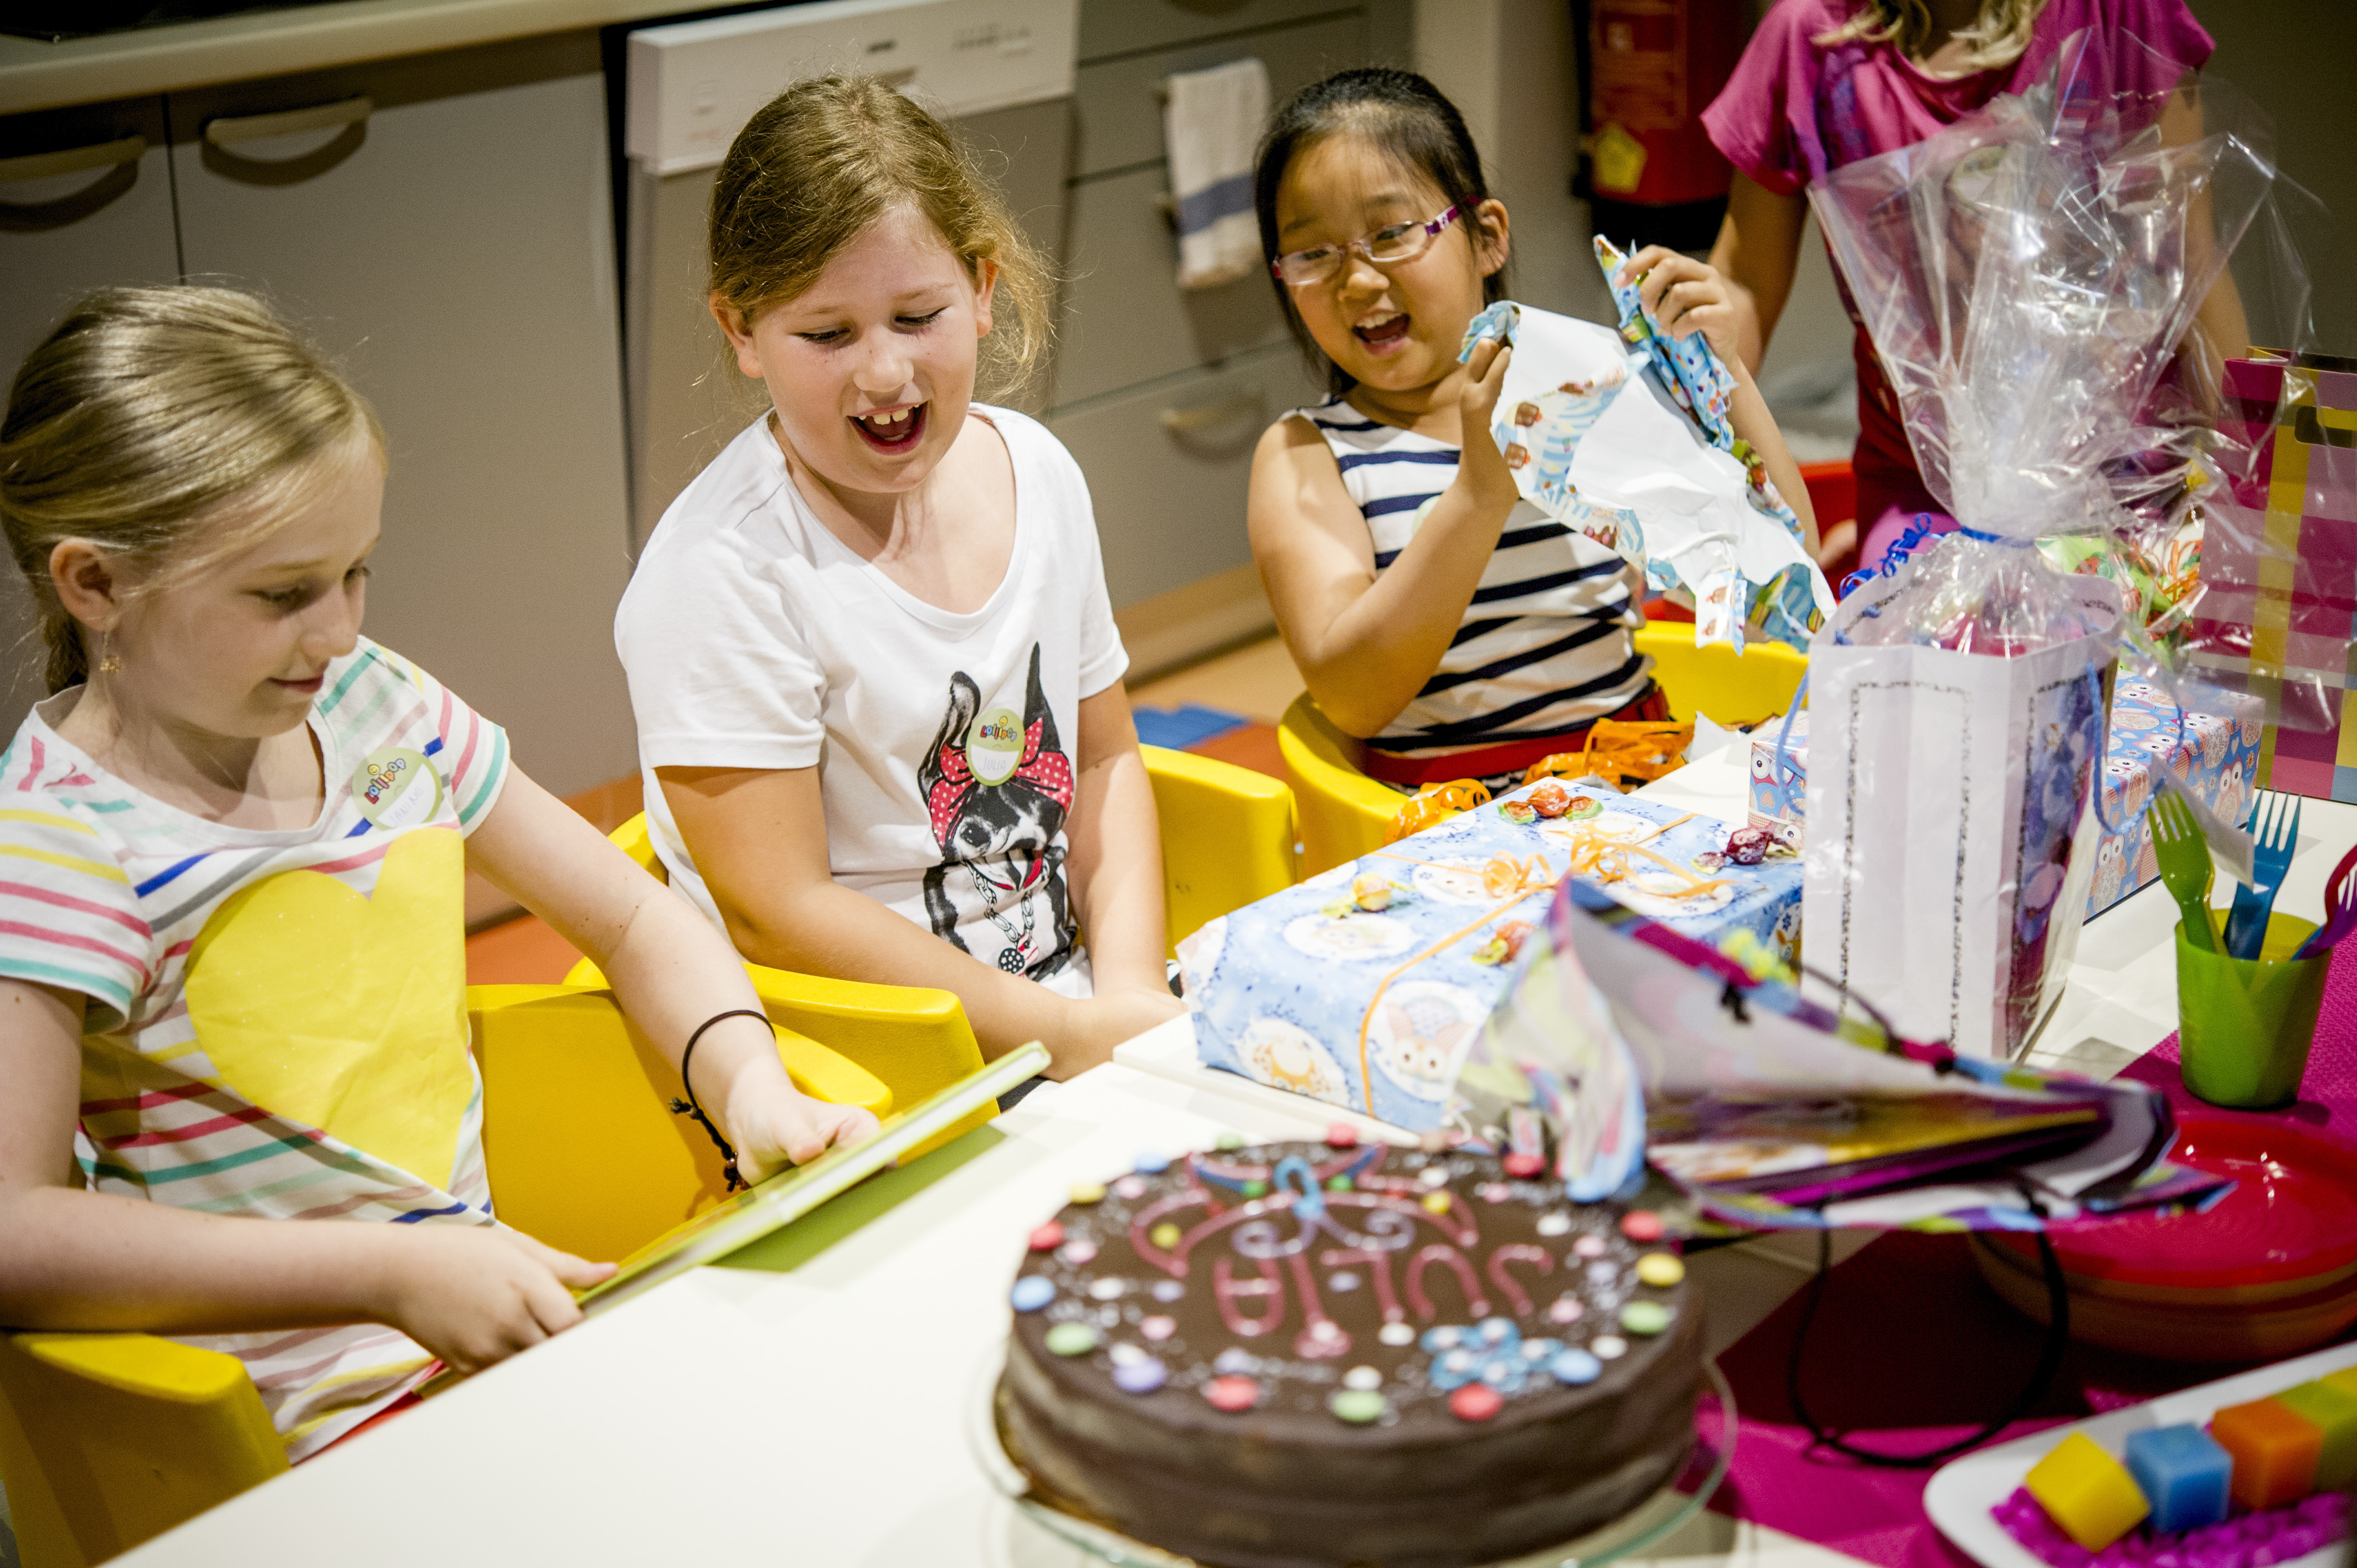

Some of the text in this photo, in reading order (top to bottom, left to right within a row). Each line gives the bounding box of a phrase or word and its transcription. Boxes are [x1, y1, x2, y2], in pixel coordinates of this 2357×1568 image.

[981, 723, 1017, 741] Lollipop
[979, 756, 1006, 771] JULIA
[364, 759, 405, 804] Lollipop
